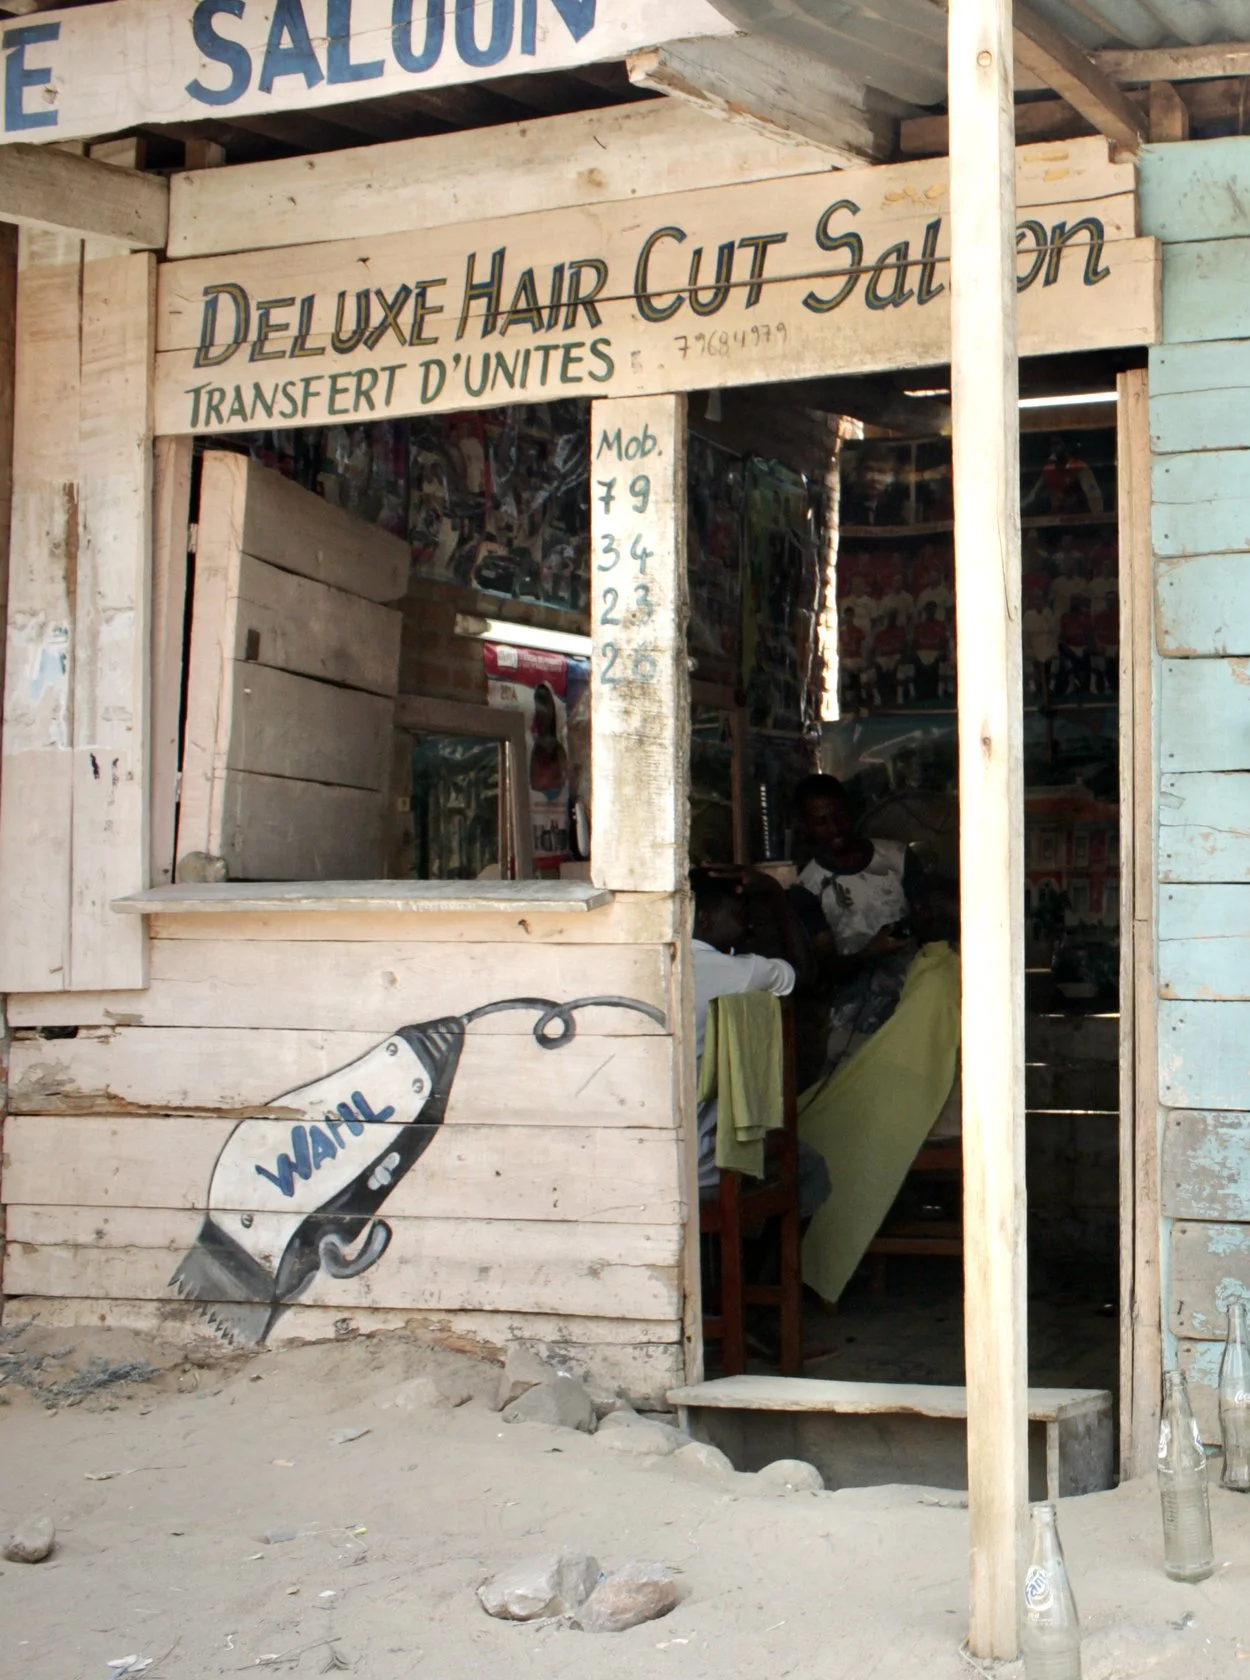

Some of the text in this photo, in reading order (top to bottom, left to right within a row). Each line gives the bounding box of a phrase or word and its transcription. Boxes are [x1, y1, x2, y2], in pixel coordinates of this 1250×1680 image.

[193, 199, 1110, 368] DELUXE HAIR CUT Salon
[184, 362, 407, 428] TRANSFERT
[419, 338, 614, 405] D'UNITES
[596, 423, 663, 461] Mob.
[254, 1090, 396, 1198] WAHL
